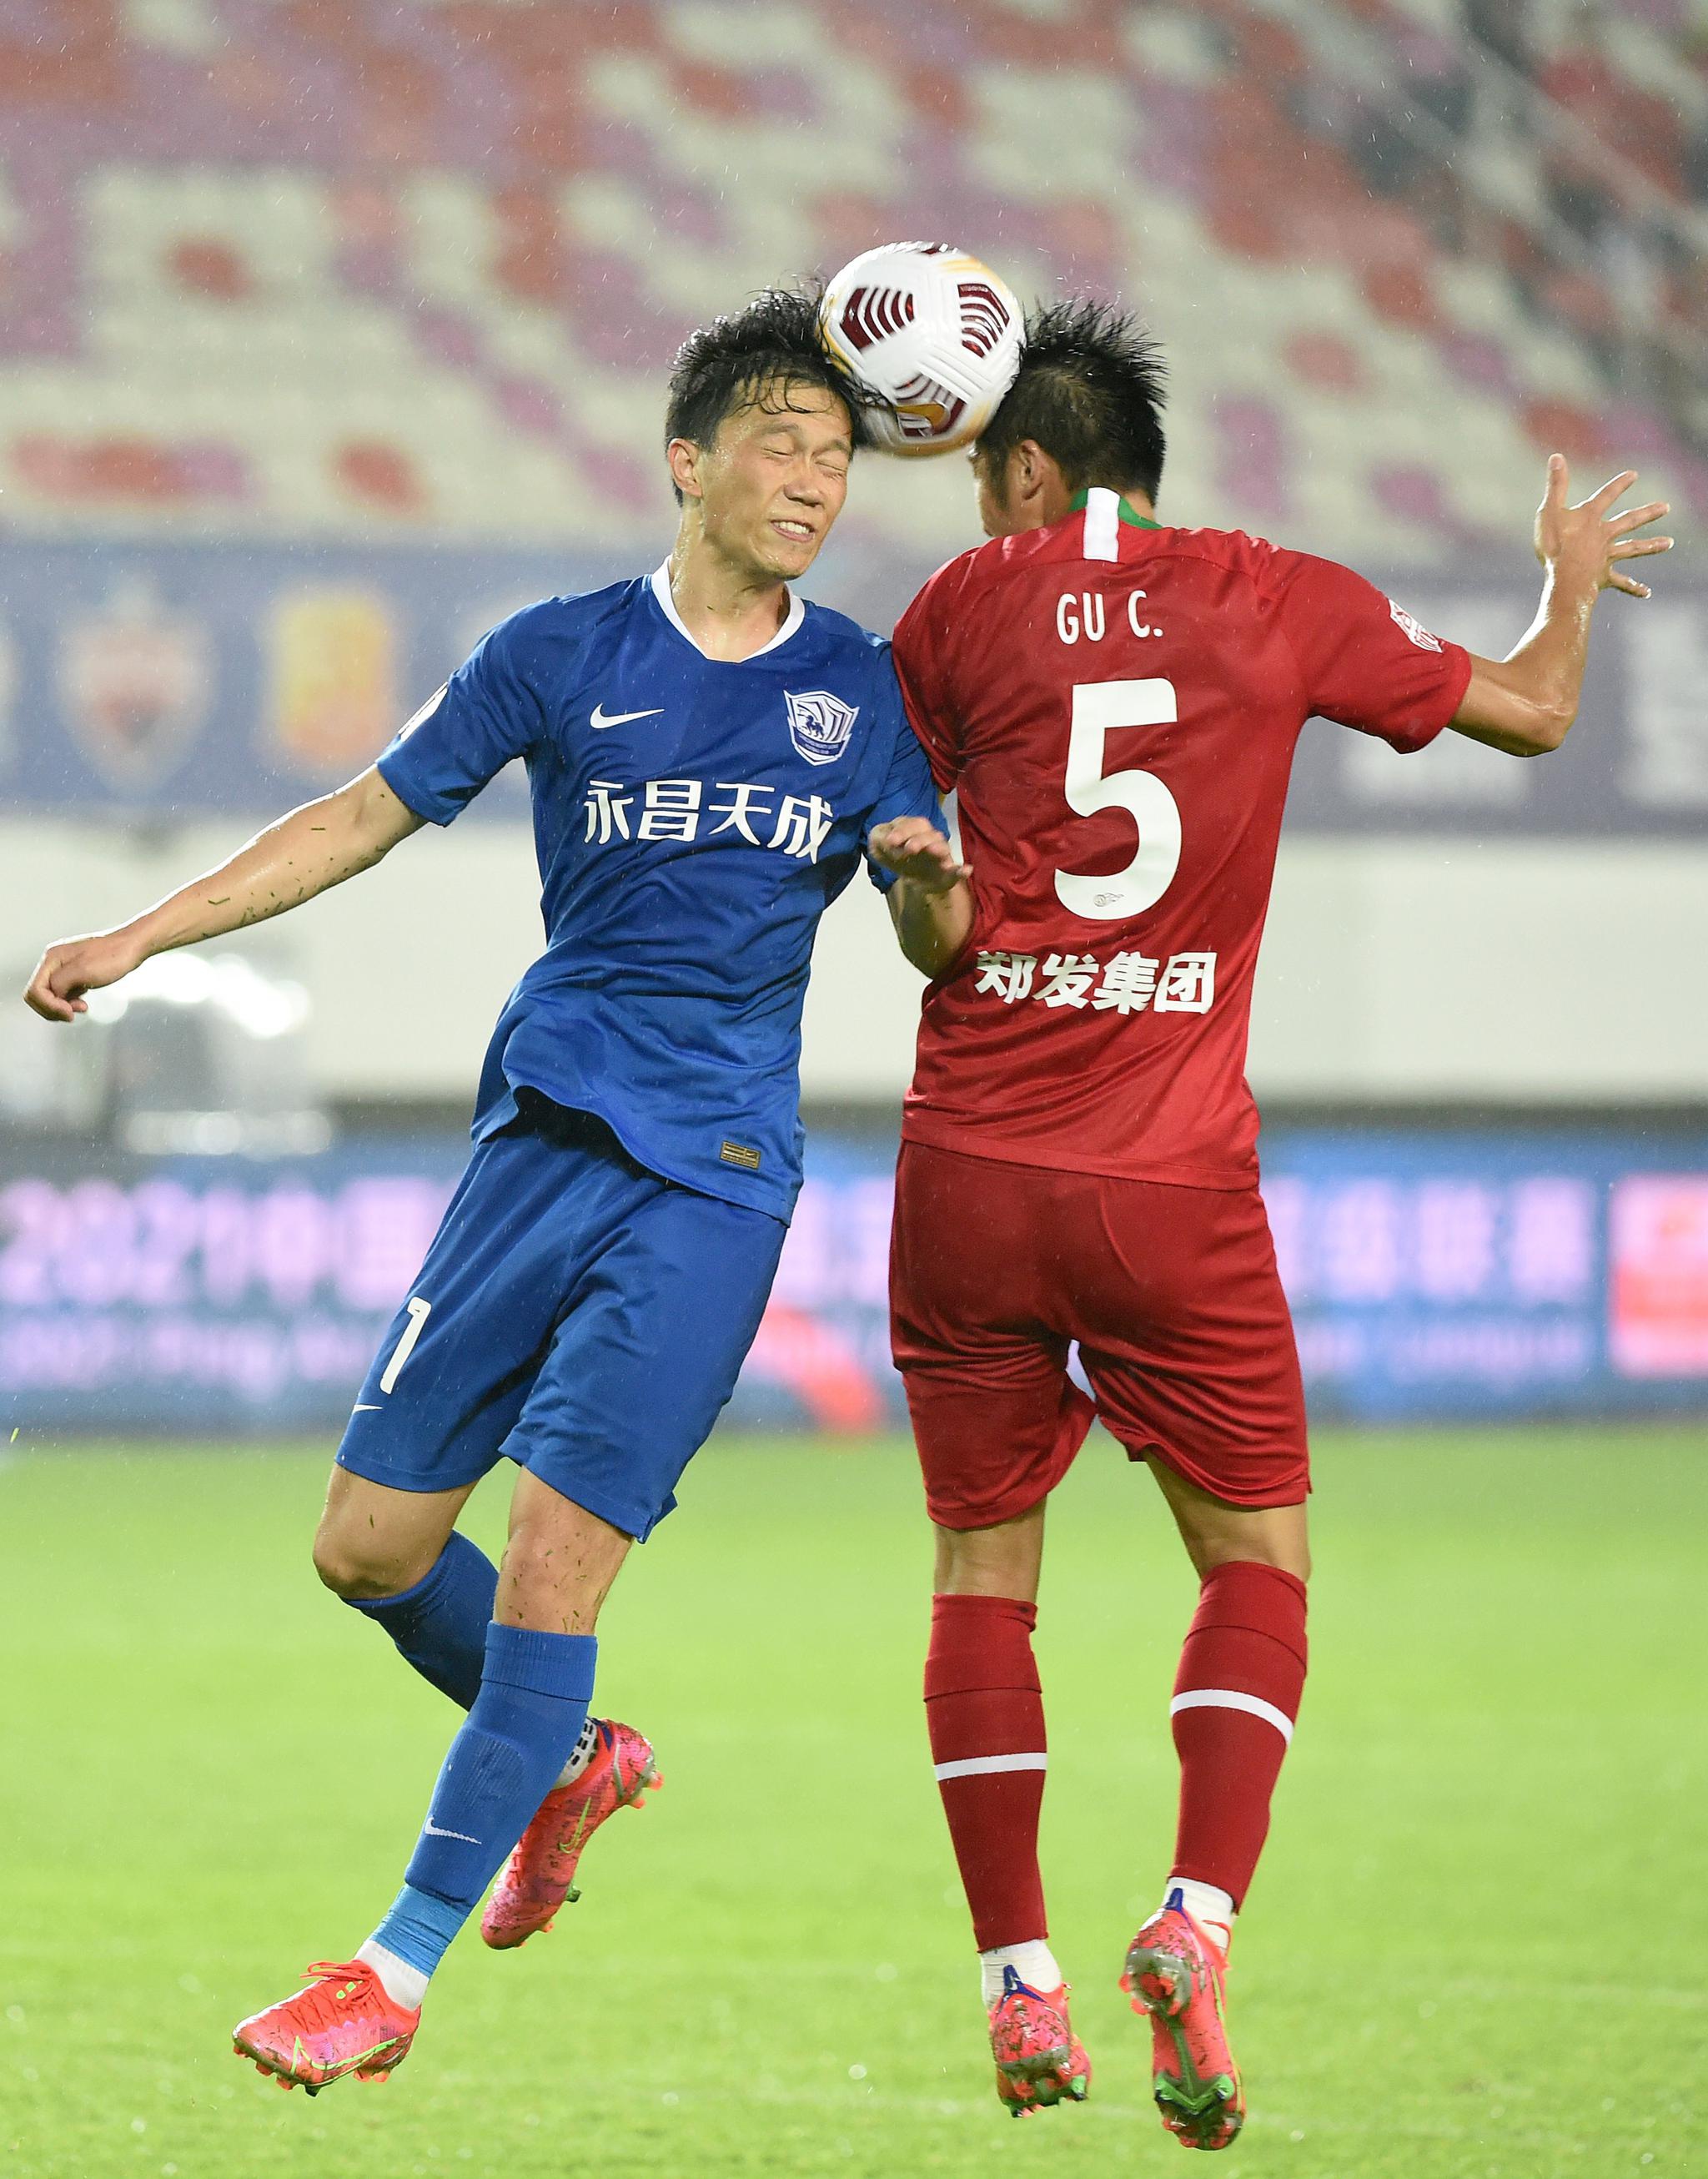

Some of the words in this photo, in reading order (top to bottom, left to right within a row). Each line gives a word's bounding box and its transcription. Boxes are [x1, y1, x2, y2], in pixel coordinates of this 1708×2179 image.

[1056, 591, 1106, 645] GU
[1128, 589, 1164, 638] C.
[583, 778, 834, 865] 永昌天成
[1054, 677, 1183, 921] 5
[973, 949, 1218, 1015] 郑发集团
[379, 1296, 432, 1395] 1
